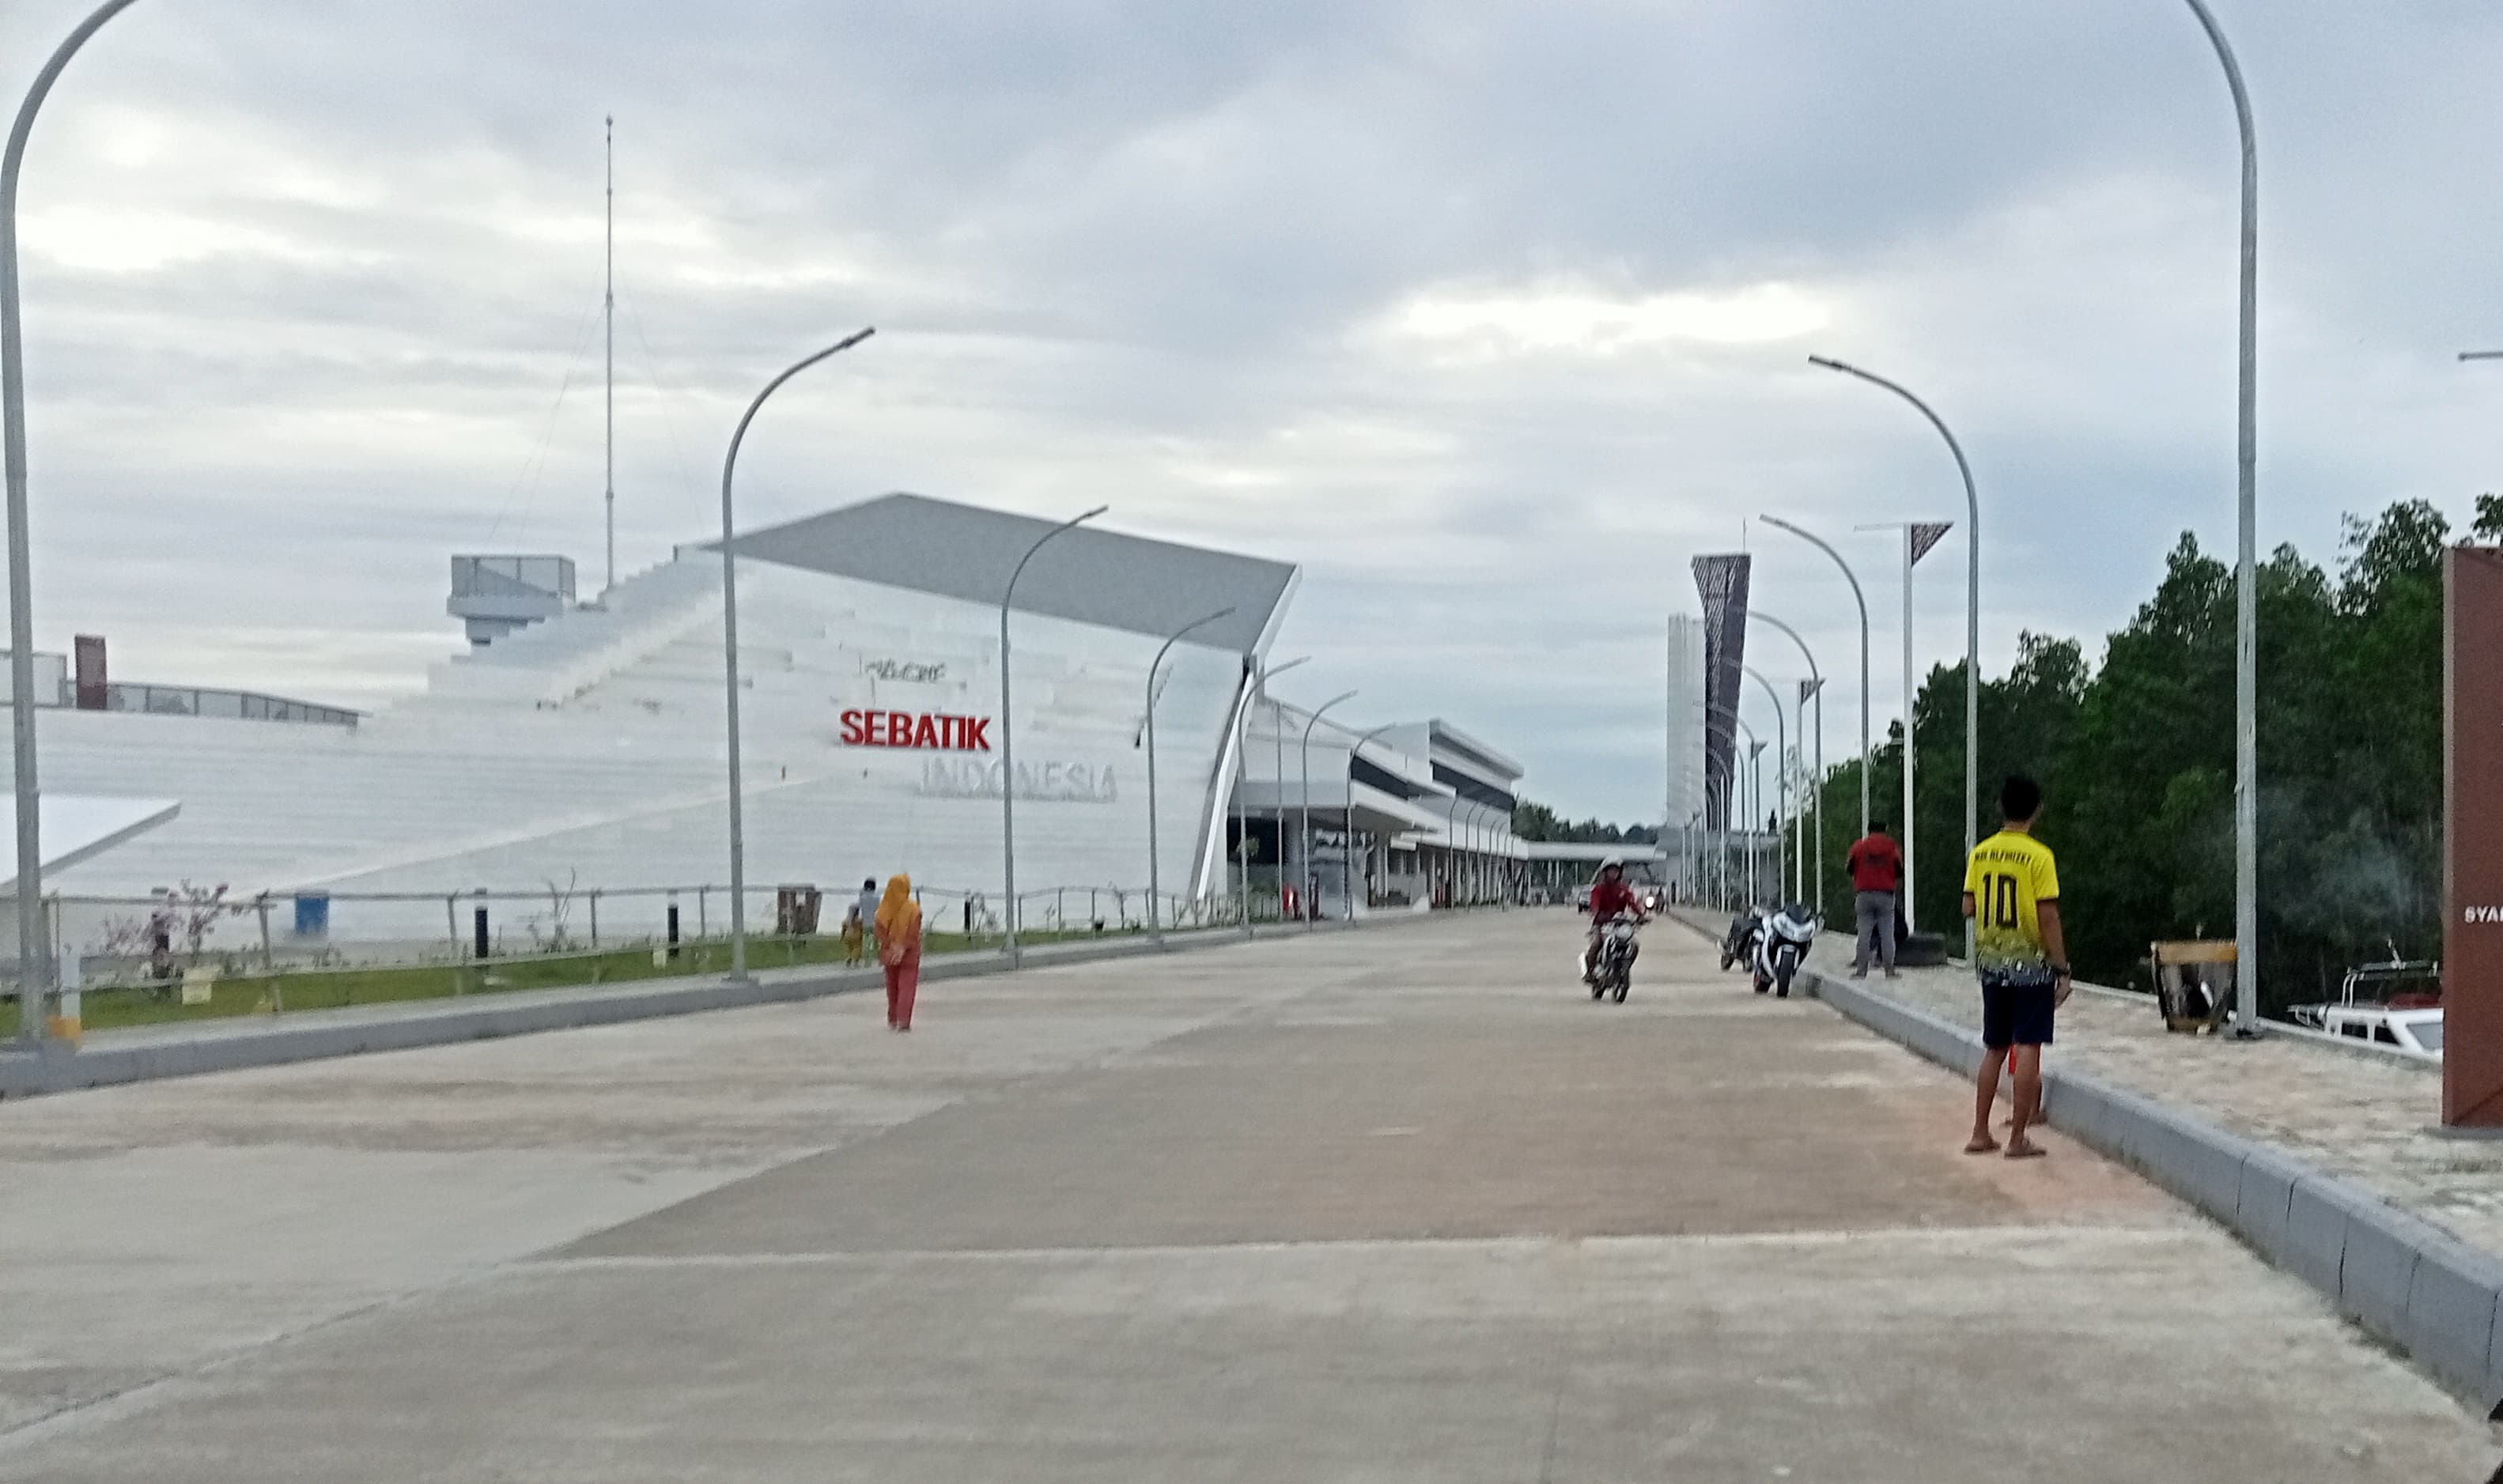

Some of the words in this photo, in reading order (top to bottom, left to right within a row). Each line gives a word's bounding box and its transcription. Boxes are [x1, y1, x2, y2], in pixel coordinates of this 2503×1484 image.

[840, 710, 989, 751] SEBATIK
[921, 756, 1117, 800] INDONESIA
[1983, 873, 2017, 928] 10
[2464, 905, 2503, 923] SYA
